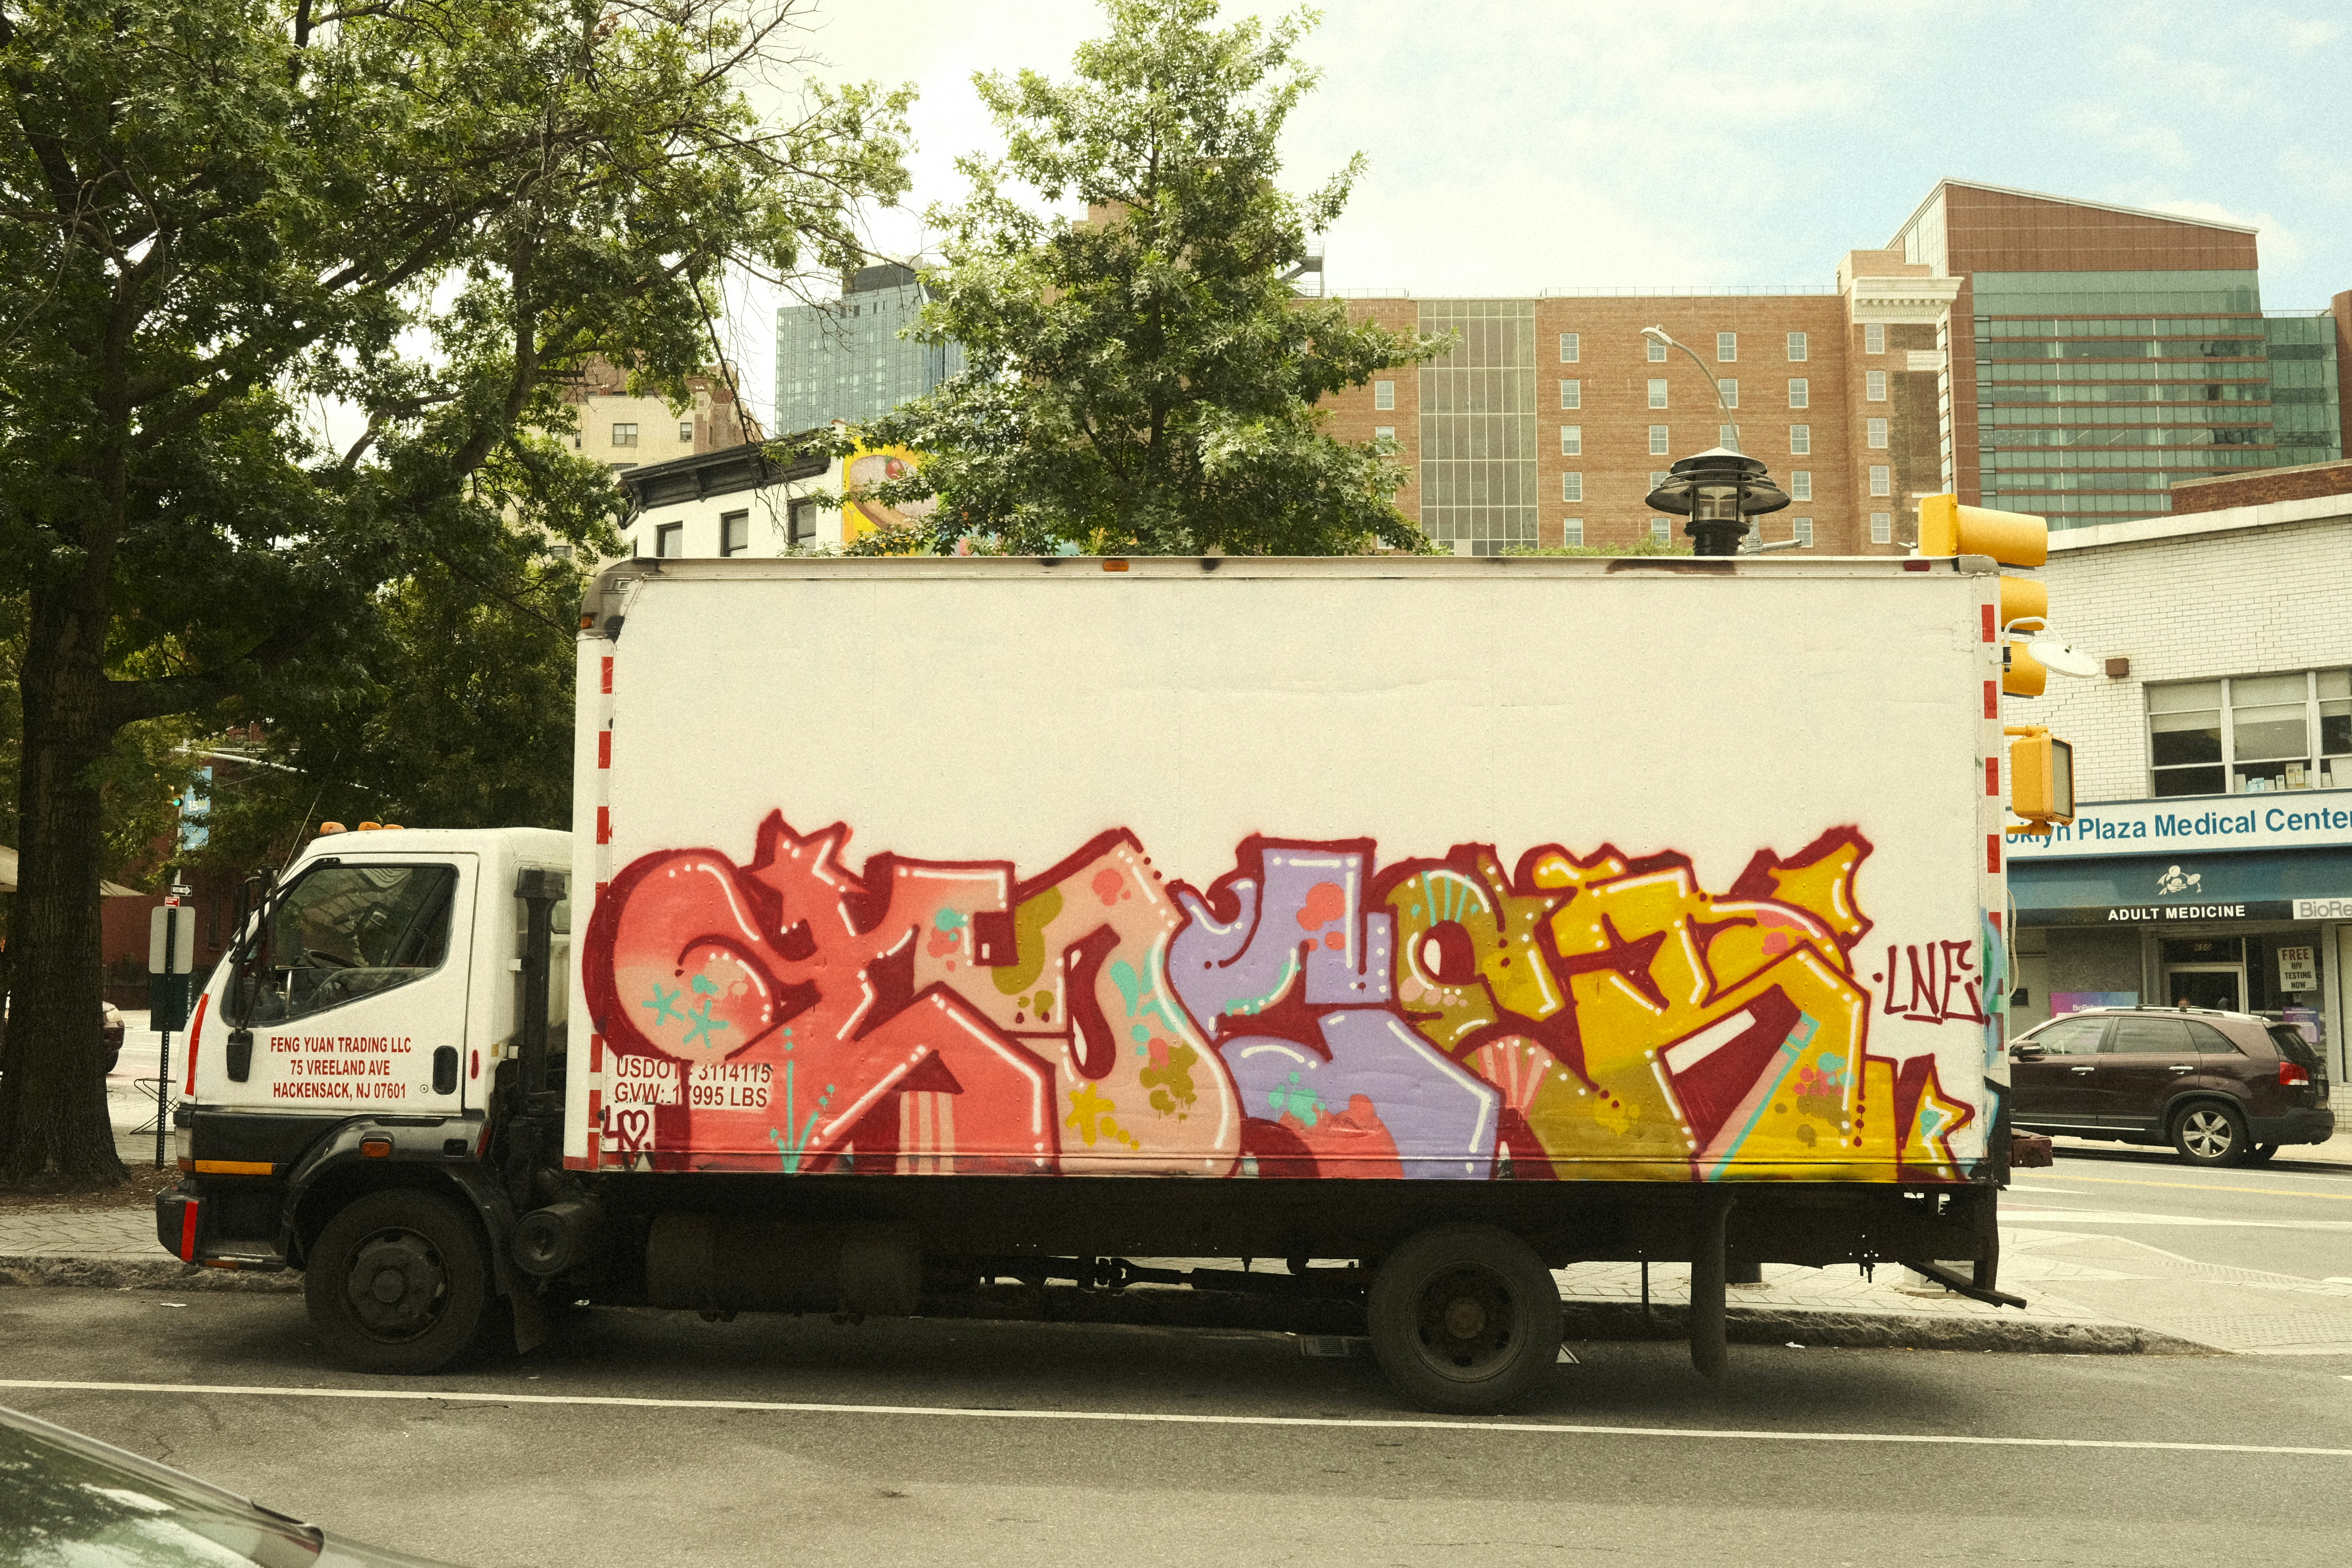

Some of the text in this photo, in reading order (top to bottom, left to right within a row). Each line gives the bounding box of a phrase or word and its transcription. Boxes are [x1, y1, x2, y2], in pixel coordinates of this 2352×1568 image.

[2078, 818, 2147, 840] Plaza
[2155, 810, 2256, 836] Medical
[2266, 808, 2352, 832] Cente
[2108, 905, 2245, 920] ADULT MEDICINE
[2282, 948, 2309, 960] FREE
[2285, 971, 2311, 980] TESTING
[271, 1037, 411, 1053] FENG YUAN TRADING LLC
[291, 1060, 390, 1075] 75 VREELAND AVE
[274, 1083, 405, 1101] HACKENSACK, NJ 07601
[673, 1084, 724, 1106] 1995
[730, 1087, 767, 1107] LBS
